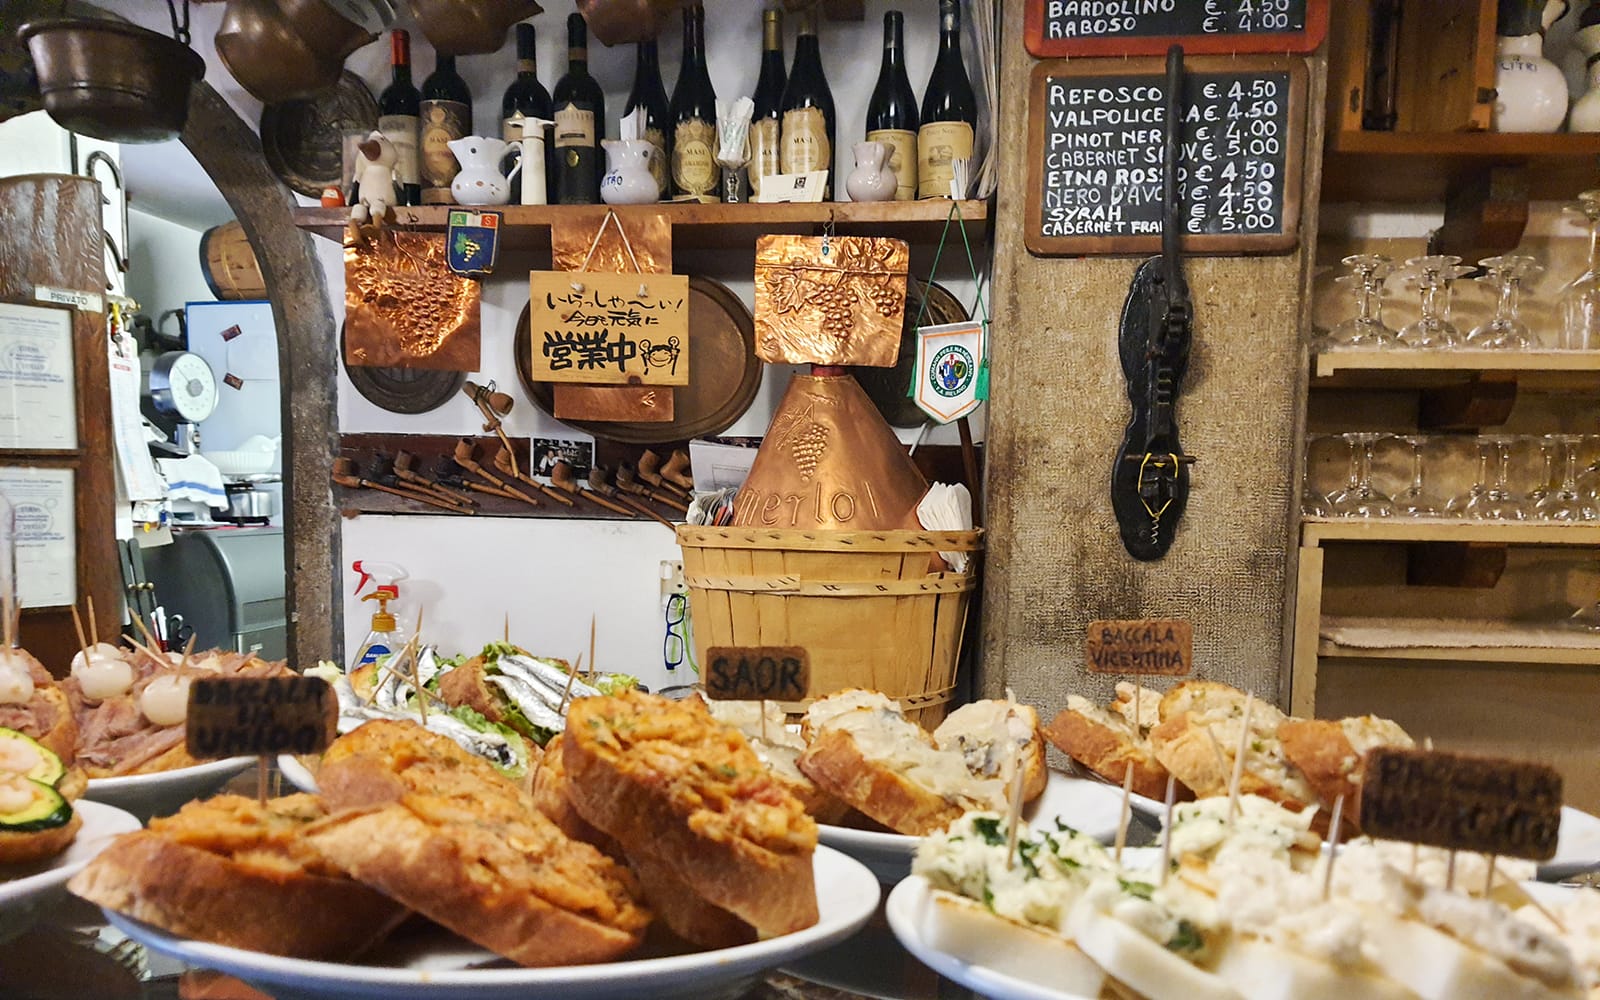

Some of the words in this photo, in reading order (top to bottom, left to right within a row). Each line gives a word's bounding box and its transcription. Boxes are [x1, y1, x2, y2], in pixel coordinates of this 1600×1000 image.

[1049, 0, 1175, 18] BARDOLINO
[1238, 0, 1290, 16] 4.50
[1049, 17, 1136, 38] RABOSO
[1239, 12, 1288, 32] 4.00
[1050, 85, 1163, 105] REFOSCO
[1228, 80, 1276, 101] 4.50
[1227, 100, 1278, 120] 4.50
[1051, 132, 1114, 150] PINOT
[1122, 129, 1162, 145] NER
[1226, 120, 1277, 142] 4.00
[1047, 147, 1139, 168] CABERNET
[1048, 169, 1107, 187] ETNA
[1047, 187, 1101, 207] NERO
[1218, 182, 1273, 198] 4.50
[1048, 205, 1121, 222] SYRAH
[1218, 197, 1272, 216] 4.50
[485, 216, 492, 225] S
[1043, 221, 1126, 235] CABERNET
[51, 292, 88, 306] PRIVATO
[564, 309, 659, 327] 今日も元気に
[543, 328, 636, 372] 営業中
[710, 656, 804, 694] SAOR
